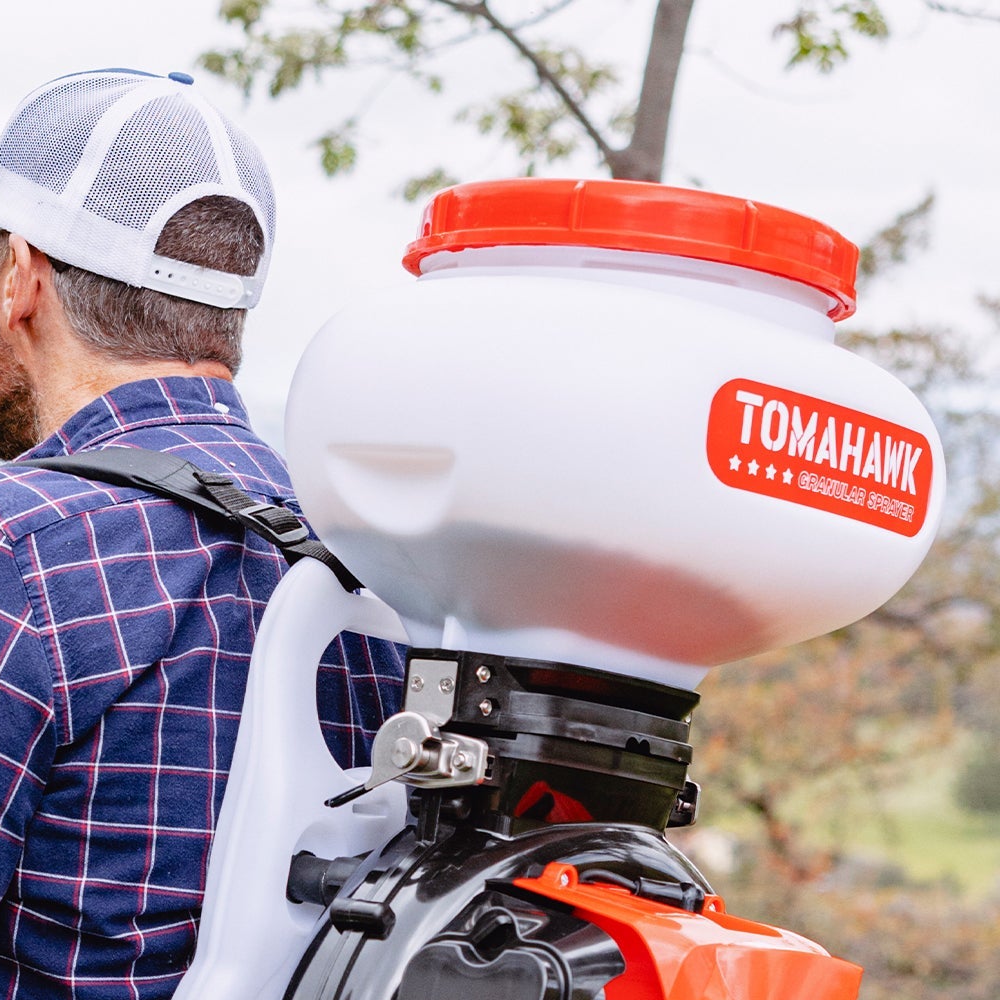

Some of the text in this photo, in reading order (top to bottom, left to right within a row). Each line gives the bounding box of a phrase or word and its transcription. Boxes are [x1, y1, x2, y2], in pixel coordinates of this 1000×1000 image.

[736, 390, 923, 496] TOMAHAWK
[797, 470, 915, 523] GRANULAR SPRAYER
